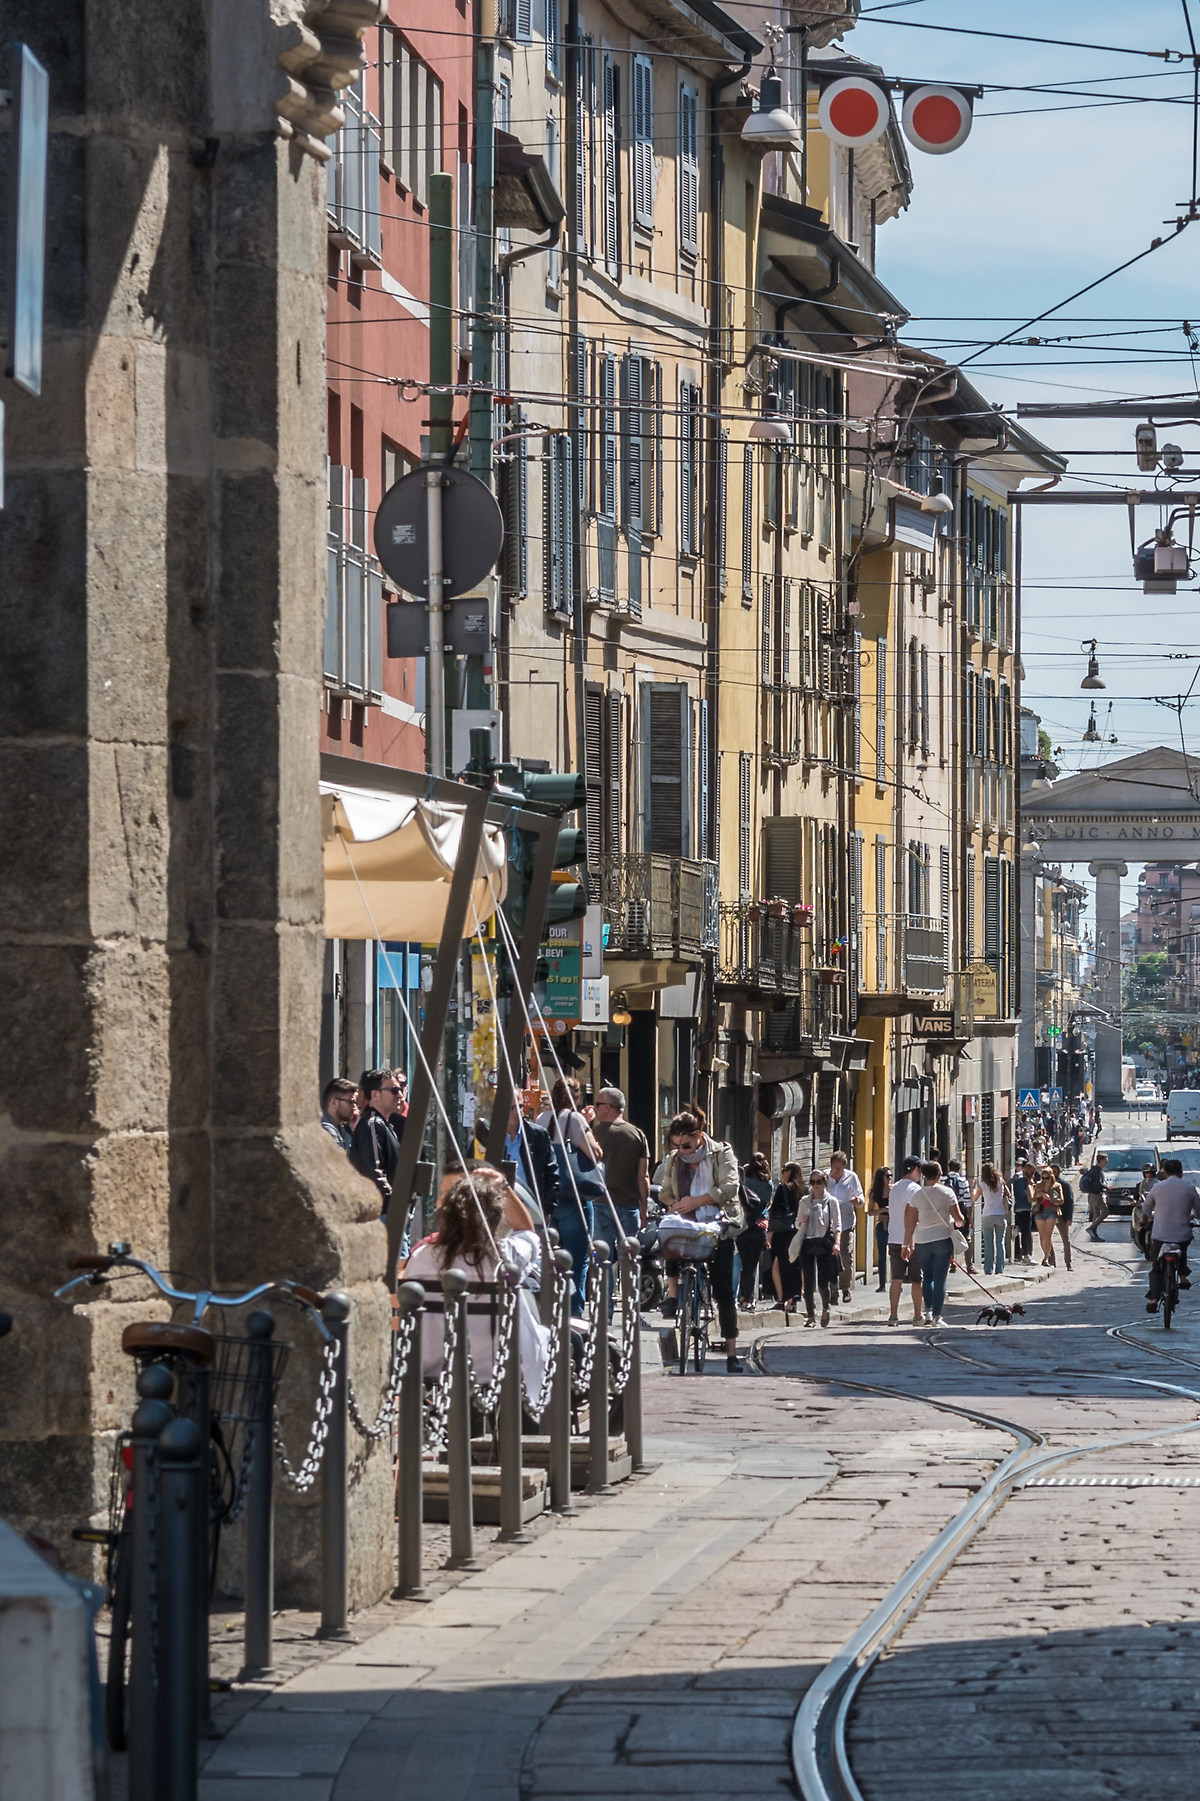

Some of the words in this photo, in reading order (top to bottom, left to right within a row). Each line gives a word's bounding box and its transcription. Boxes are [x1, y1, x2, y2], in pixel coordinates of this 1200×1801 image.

[1118, 827, 1174, 838] ANNO
[549, 927, 567, 938] OUR
[545, 949, 564, 958] BEVI
[961, 979, 995, 988] GEATERIA
[914, 1016, 952, 1032] VANS
